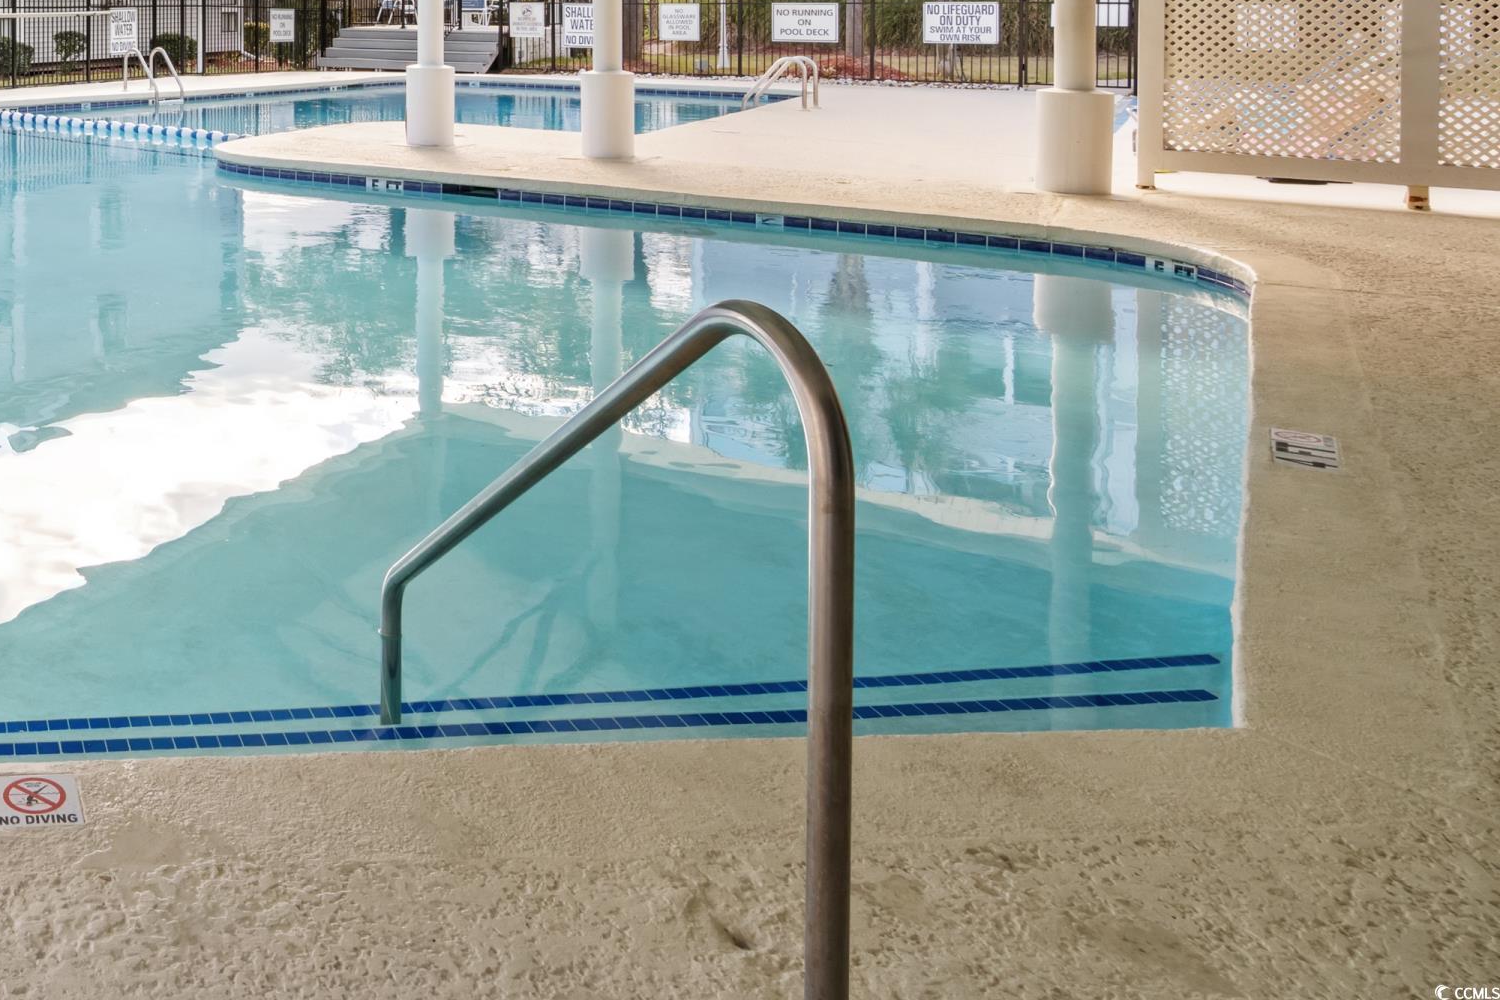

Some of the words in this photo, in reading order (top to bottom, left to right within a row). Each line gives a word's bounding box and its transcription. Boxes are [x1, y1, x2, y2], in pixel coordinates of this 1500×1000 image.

[566, 6, 593, 18] SHALL
[926, 4, 940, 15] NO
[942, 4, 994, 15] LIFEGUARD
[940, 16, 952, 26] ON
[956, 16, 981, 26] DUTY
[968, 26, 992, 34] YOUR
[566, 36, 576, 44] NO
[0, 816, 20, 826] NO
[26, 814, 78, 824] DIVING
